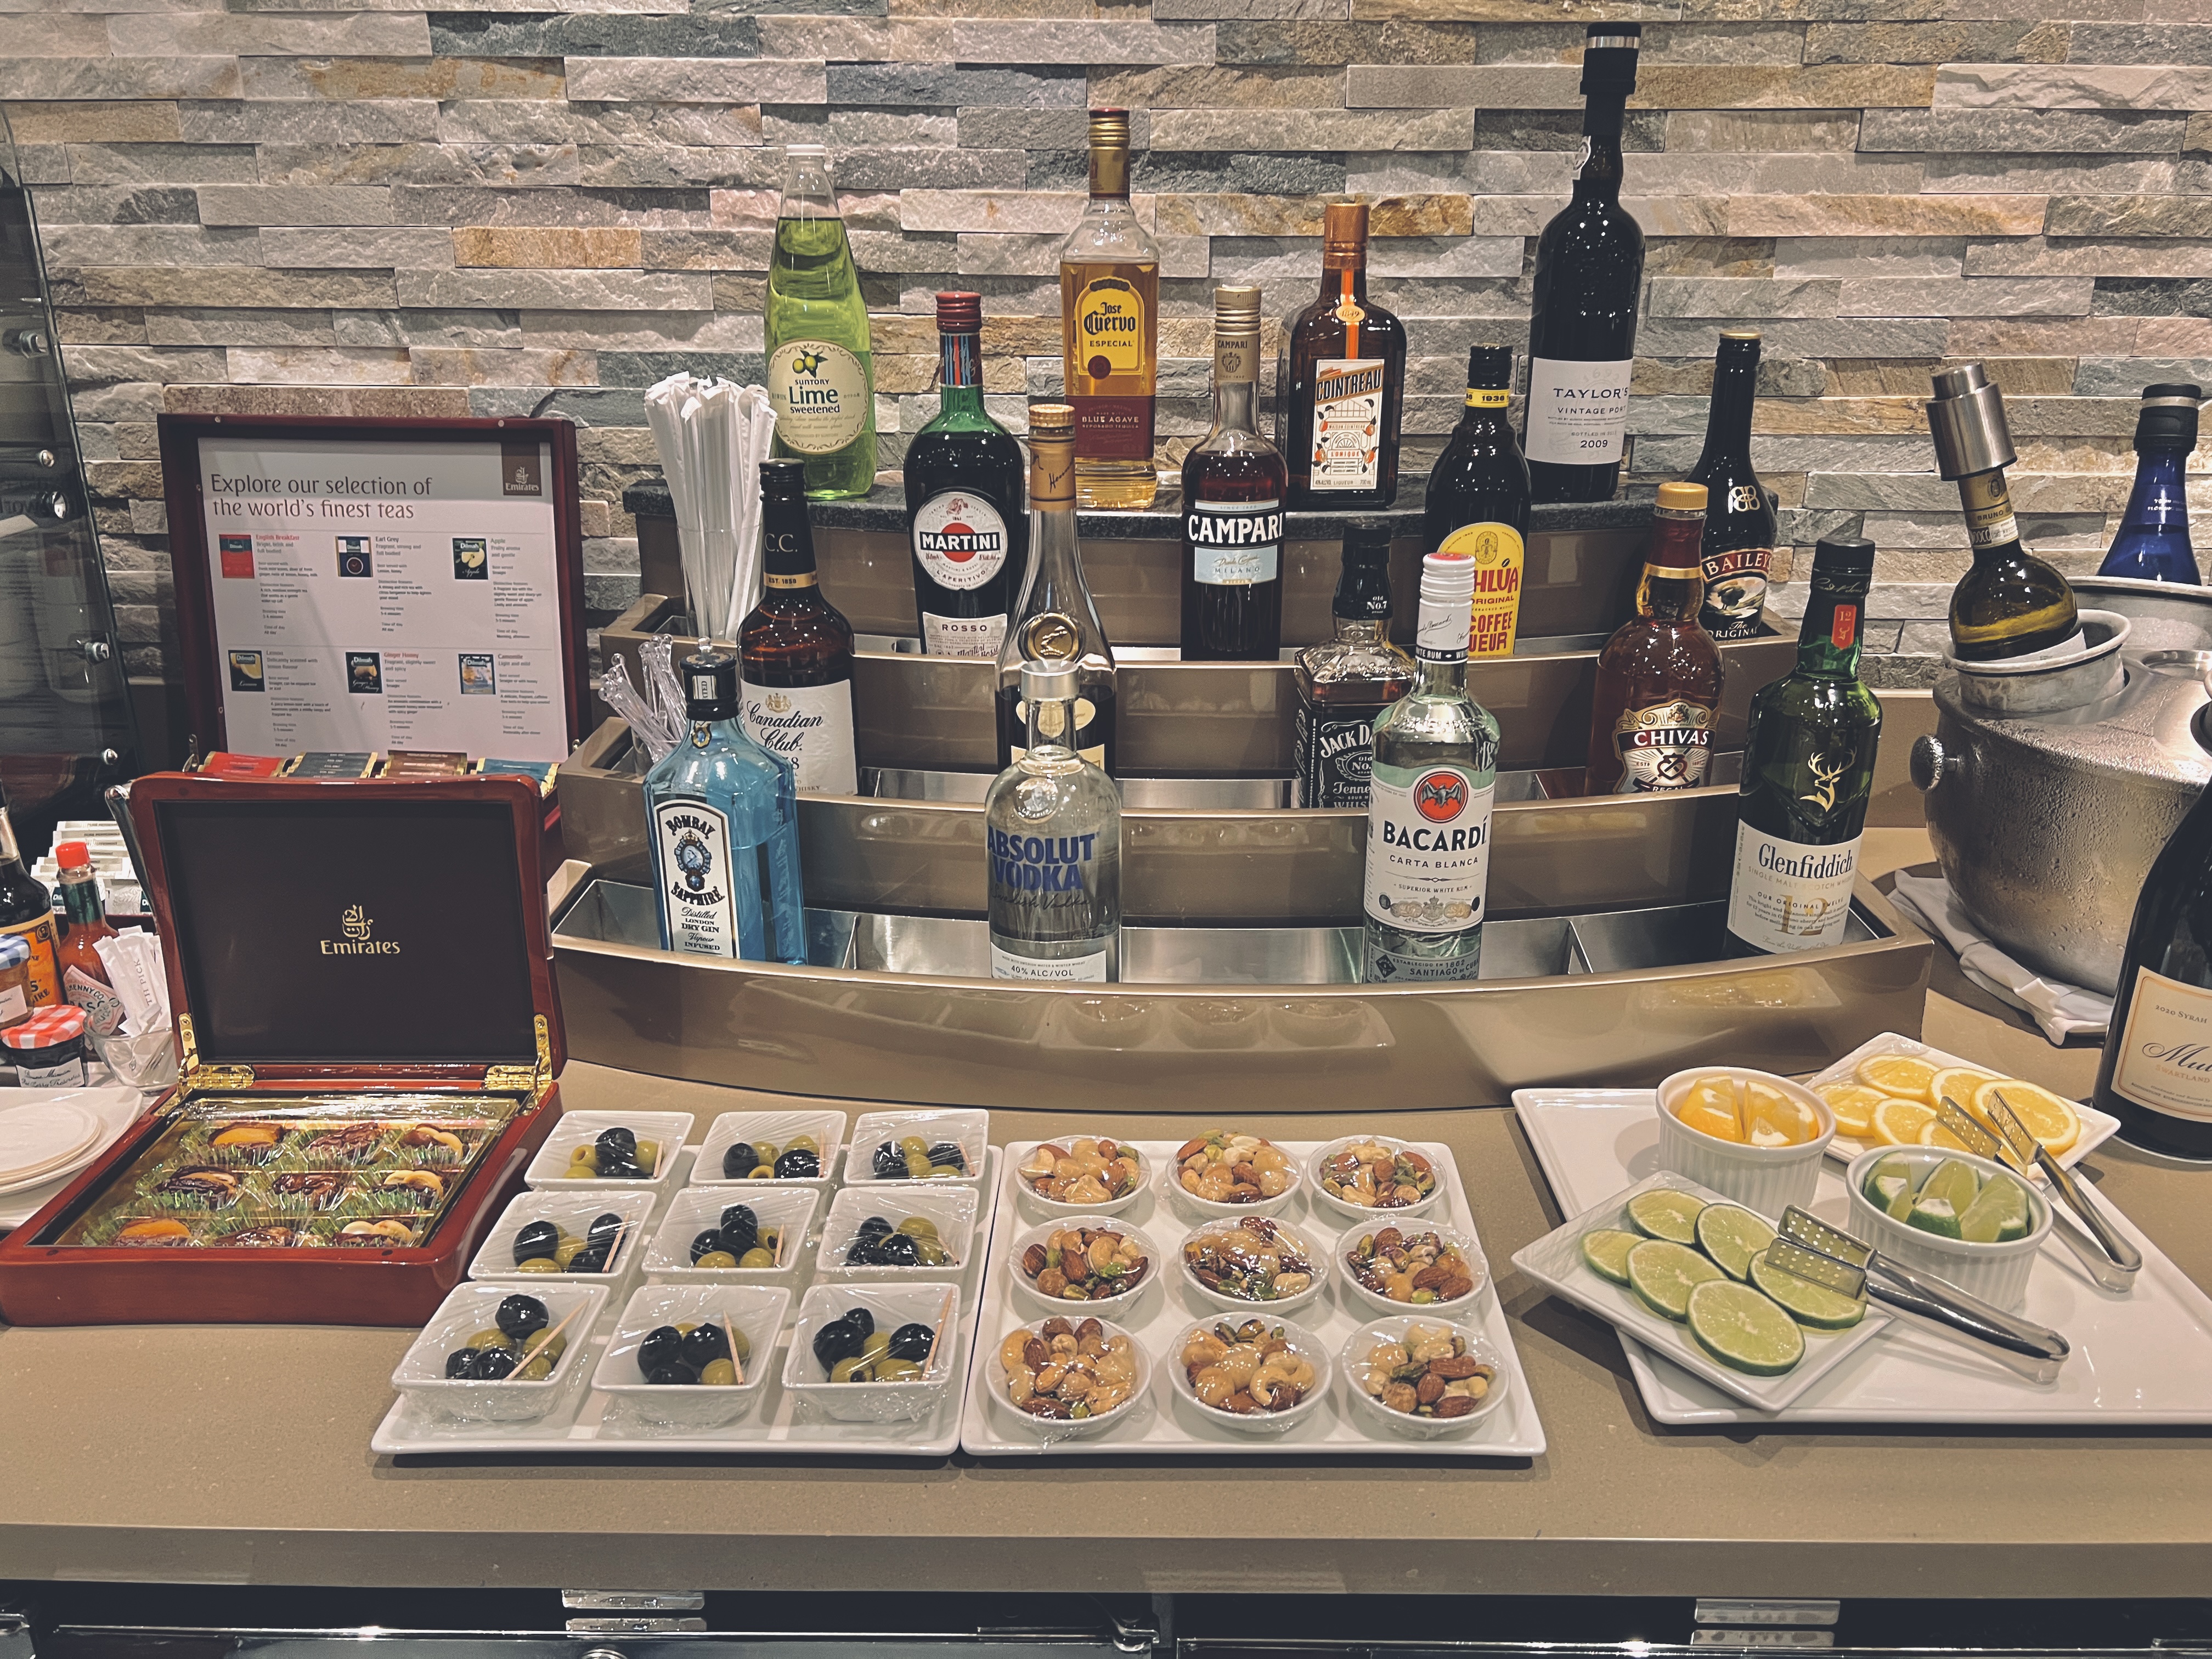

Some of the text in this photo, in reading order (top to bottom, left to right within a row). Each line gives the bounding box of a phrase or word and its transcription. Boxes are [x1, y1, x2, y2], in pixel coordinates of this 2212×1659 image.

[1101, 302, 1122, 316] Jose
[1084, 311, 1136, 335] Cuervo
[1218, 340, 1247, 348] CAMPARI
[1317, 369, 1382, 401] COINTREAU
[1553, 387, 1628, 398] TAYLOR'S
[789, 386, 838, 404] Lime
[791, 404, 840, 414] sweetened
[1580, 439, 1607, 448] 2009
[211, 474, 432, 496] Explore our selection of
[505, 482, 539, 492] Emirates
[213, 499, 414, 518] the world's finest teas
[1977, 510, 2004, 521] BRUNO
[1188, 512, 1283, 544] CAMPARI
[922, 534, 997, 550] MARTINI
[1706, 553, 1771, 575] BAILEYS
[936, 569, 985, 582] L'APERITIVO
[1470, 611, 1513, 633] COFFEE
[1839, 611, 1851, 621] 12
[1729, 621, 1748, 630] The
[1427, 650, 1441, 659] RUM
[747, 701, 823, 728] Canadian
[1320, 730, 1357, 758] JACK
[1634, 730, 1709, 746] CHIVAS
[665, 815, 715, 839] BOMBAY
[1383, 815, 1487, 851] BACARDÍ
[988, 825, 1095, 864] ABSOLUT
[1390, 855, 1478, 868] CARTA BLANCA
[1759, 843, 1853, 879] Glenfiddich
[992, 855, 1084, 891] VODKA
[1748, 866, 1773, 881] SINGLE
[1776, 877, 1797, 888] MALT
[671, 882, 725, 905] SAPPHIRE
[1398, 884, 1431, 893] SUPERIOR
[1758, 891, 1844, 909] OUR ORIGINAL TWELVE
[681, 907, 717, 919] Distilled
[1775, 894, 1828, 935] 12
[685, 942, 720, 950] INFUSED
[688, 933, 714, 943] Vapour
[320, 939, 400, 955] Emirates
[1011, 966, 1028, 975] 40%
[1393, 958, 1433, 967] ESTABLECIDO
[1446, 960, 1465, 968] 1862
[134, 959, 146, 985] PICK
[1410, 968, 1457, 976] SANTIAGO
[2155, 1005, 2207, 1024] 2020 SYRAH
[2155, 1064, 2210, 1084] SWARTLAND
